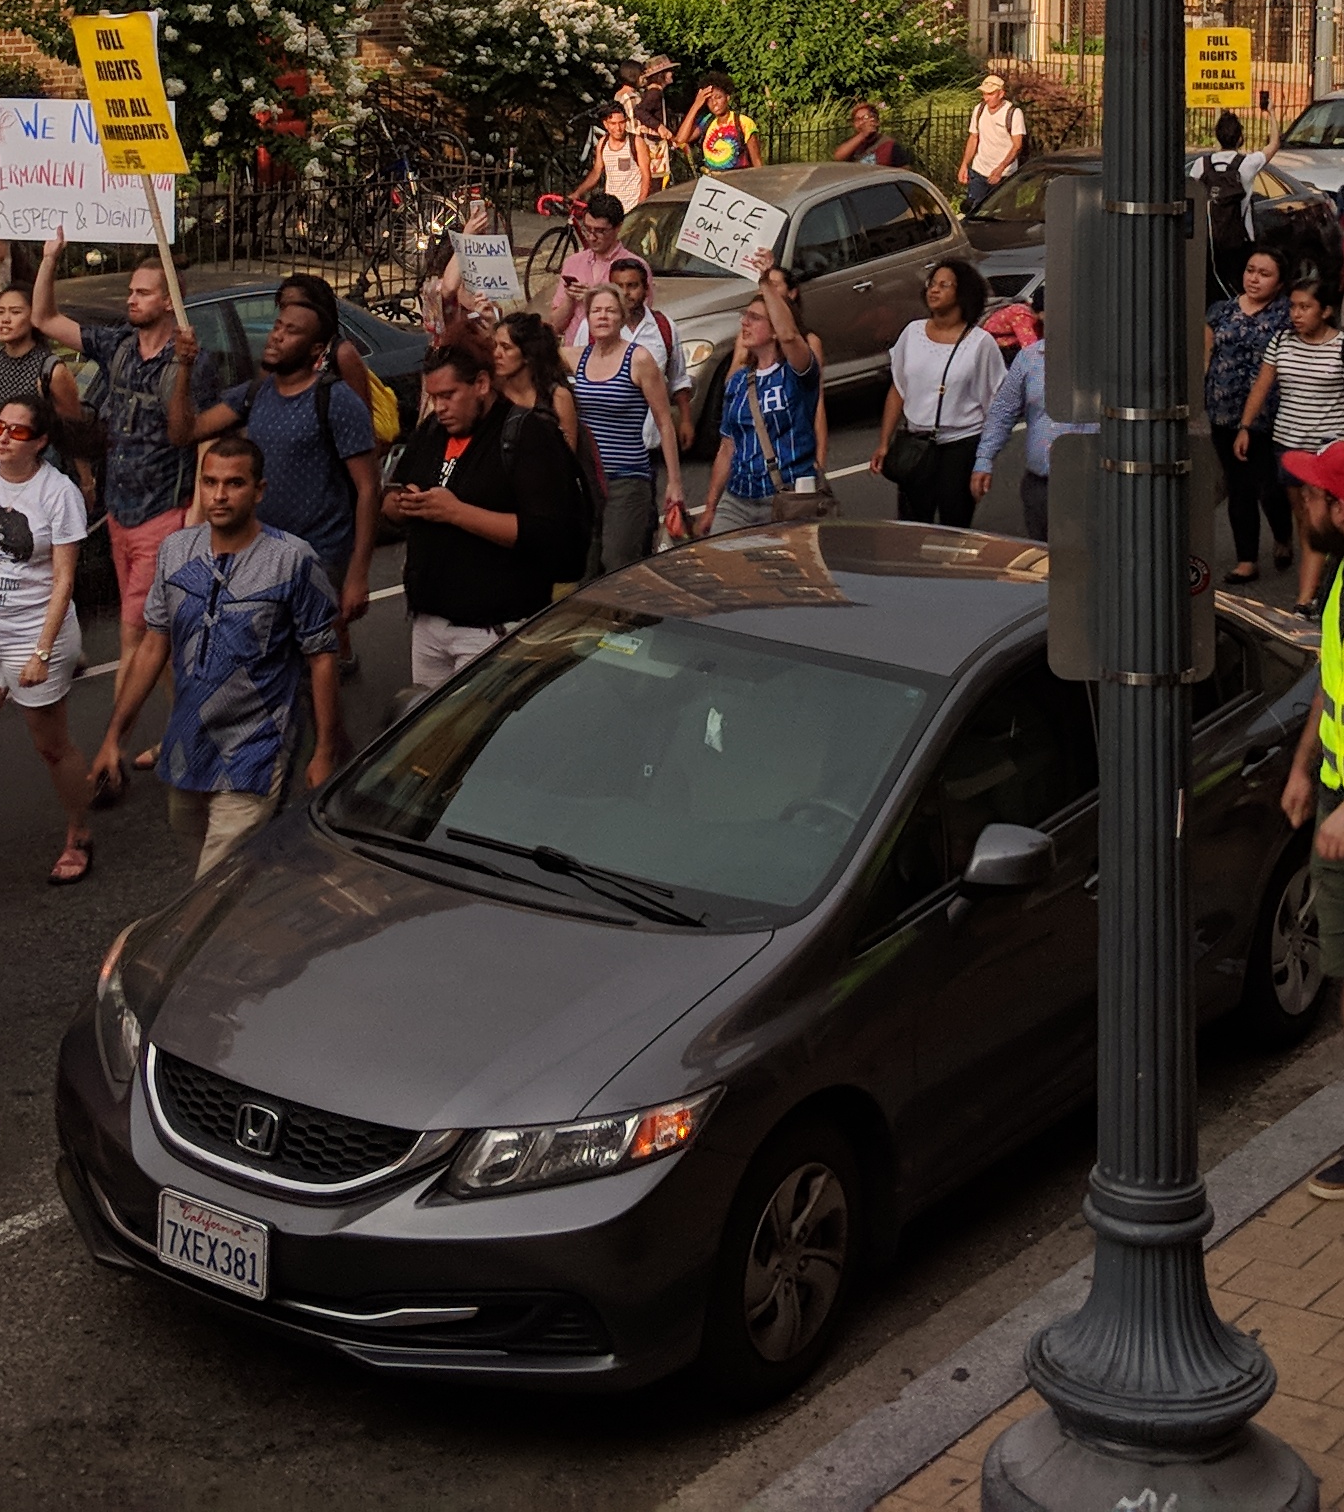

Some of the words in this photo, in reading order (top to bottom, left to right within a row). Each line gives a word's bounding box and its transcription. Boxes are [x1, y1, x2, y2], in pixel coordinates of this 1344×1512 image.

[95, 28, 125, 51] FULL
[1207, 35, 1230, 47] FULL
[1199, 50, 1238, 61] RIGHTS
[94, 59, 143, 82] RIGHTS
[1201, 69, 1218, 79] FOR
[1221, 69, 1236, 79] ALL
[1191, 81, 1246, 91] IMMIGRANTS
[104, 98, 128, 119] FOR
[129, 97, 152, 117] ALL
[14, 102, 56, 140] WE
[101, 123, 170, 141] IMMIGRANTS
[75, 201, 88, 231] &
[698, 187, 767, 231] I.C.E.
[464, 239, 506, 256] HUMAN
[732, 232, 753, 248] of
[703, 237, 739, 268] DC!
[762, 384, 786, 414] H
[181, 1204, 248, 1242] California
[167, 1218, 260, 1288] 7XEX381
